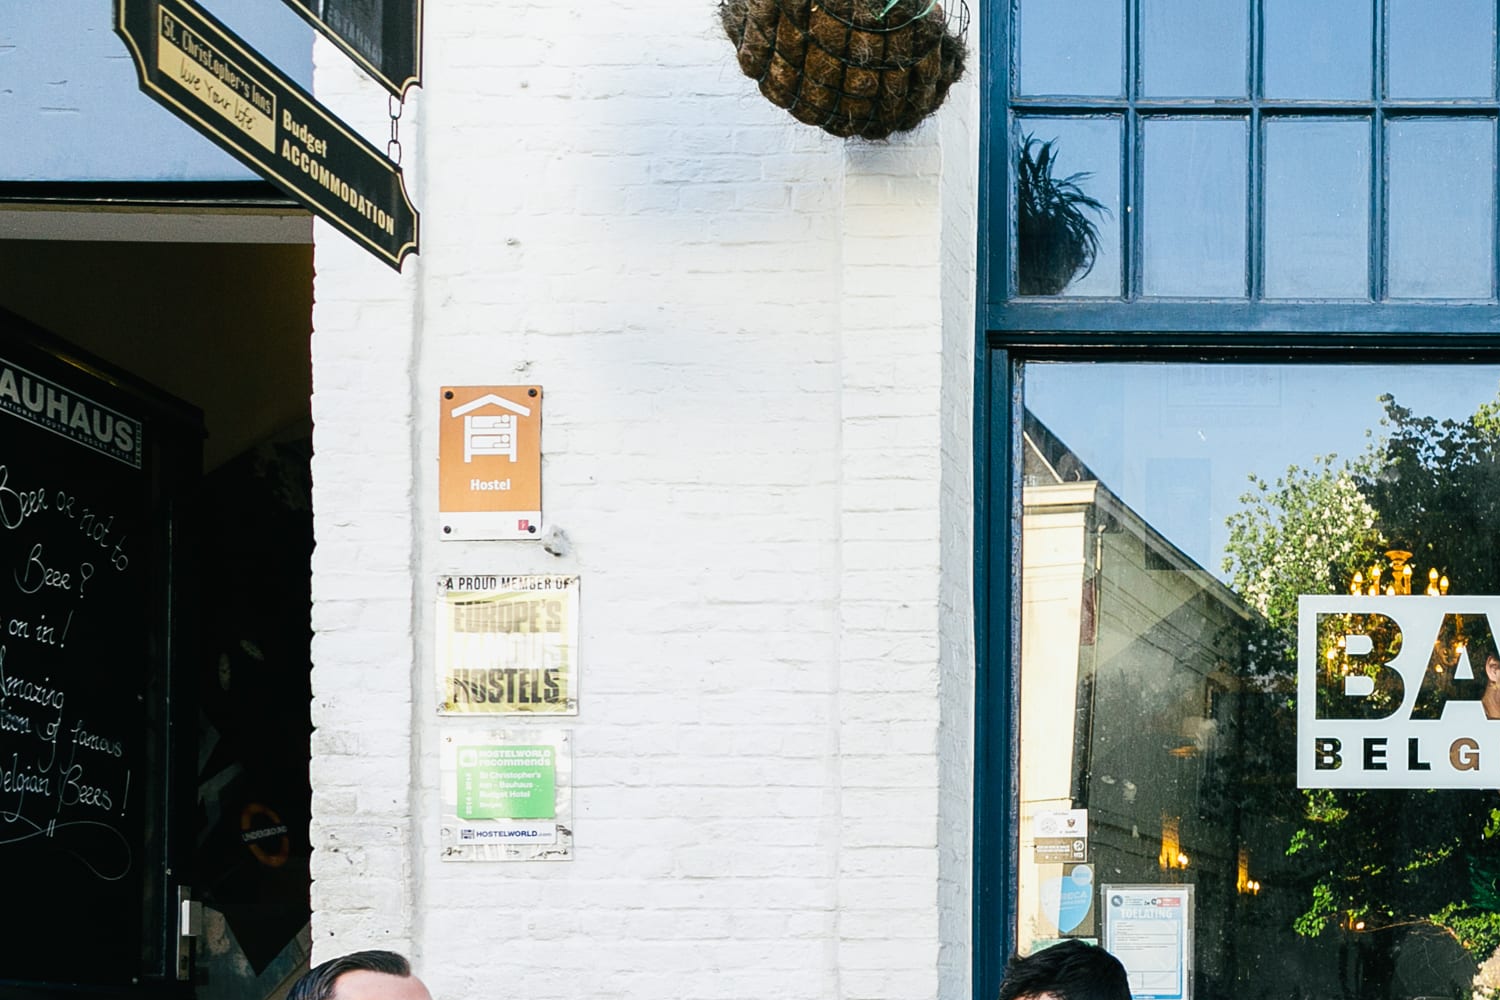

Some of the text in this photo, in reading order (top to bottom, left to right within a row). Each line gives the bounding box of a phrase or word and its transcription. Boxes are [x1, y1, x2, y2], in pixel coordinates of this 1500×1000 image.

[164, 15, 272, 115] St. Christopher's Inns
[282, 108, 328, 159] Budget
[281, 138, 395, 236] ACCOMMODATION
[470, 479, 511, 491] Hostel
[79, 507, 114, 547] not
[111, 536, 128, 571] to
[446, 577, 455, 590] A
[458, 577, 497, 590] PROUD
[8, 618, 31, 638] on
[453, 599, 561, 633] EUROPE'S
[453, 667, 560, 704] HOSTELS
[479, 757, 552, 767] recommends
